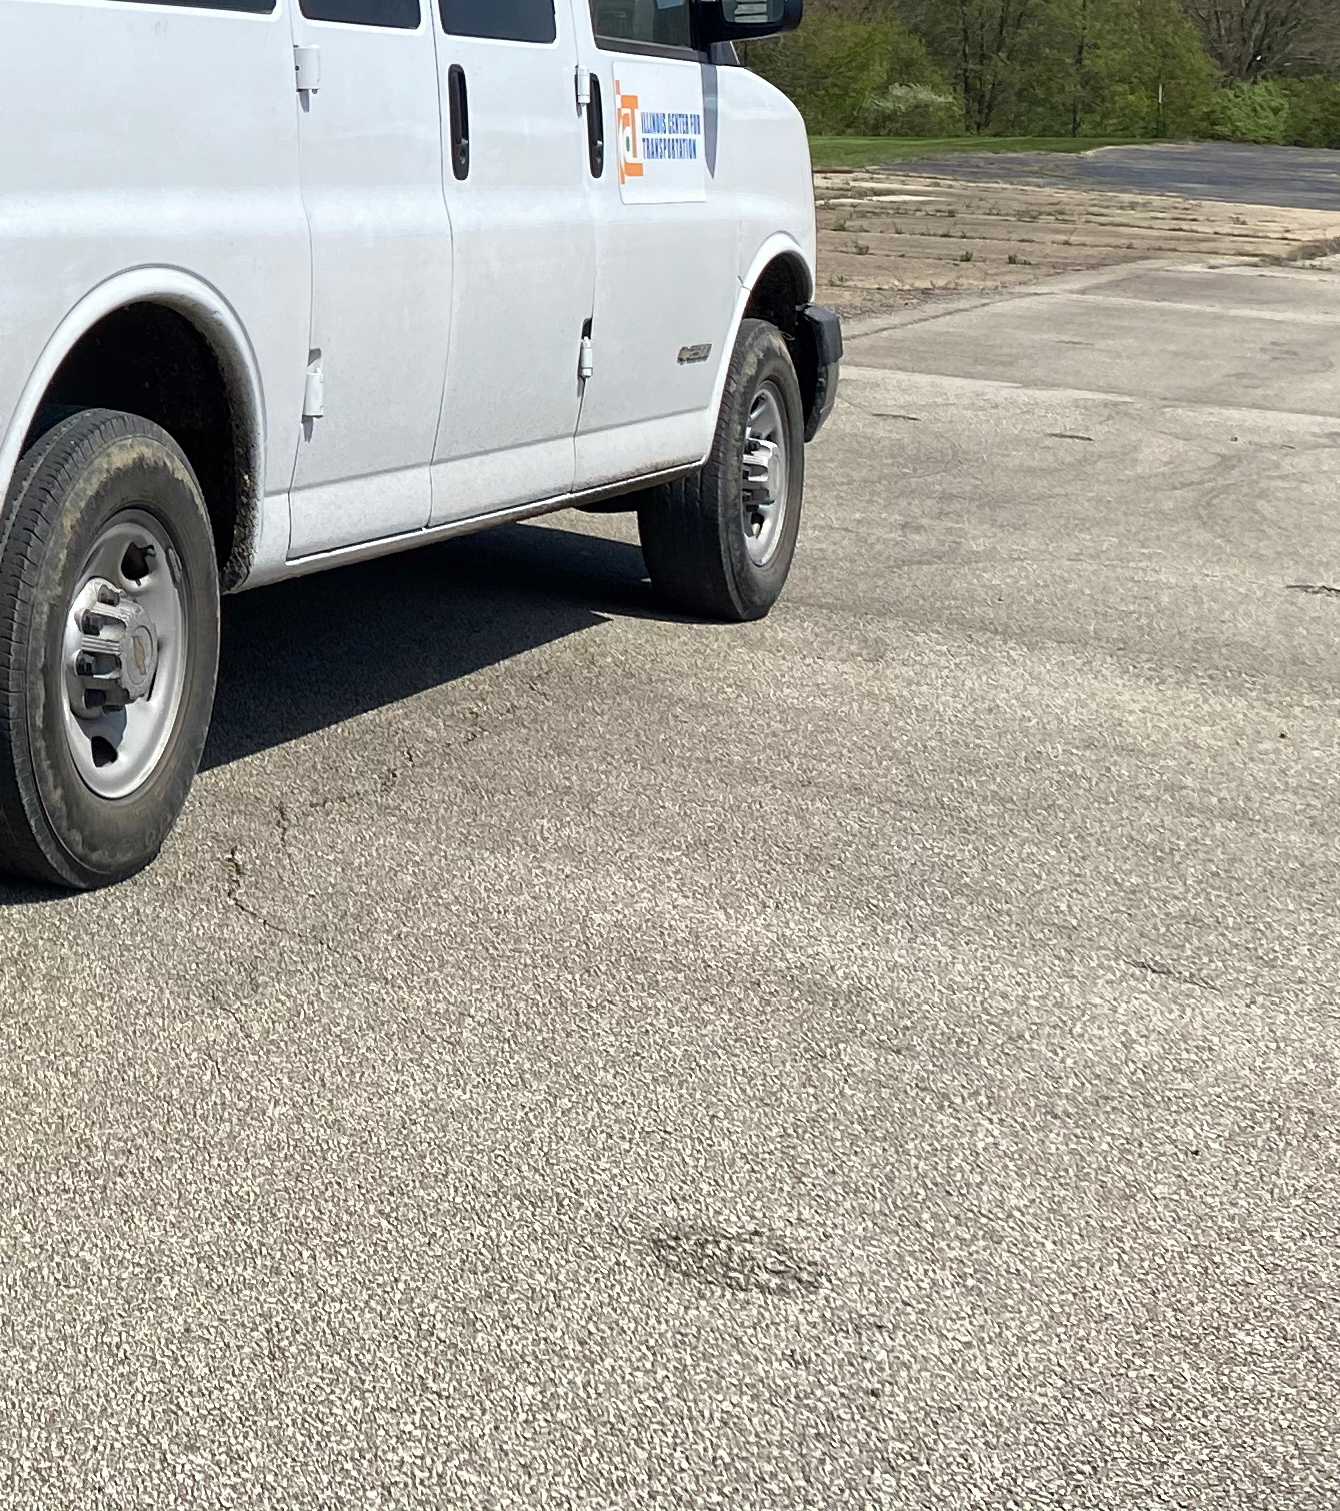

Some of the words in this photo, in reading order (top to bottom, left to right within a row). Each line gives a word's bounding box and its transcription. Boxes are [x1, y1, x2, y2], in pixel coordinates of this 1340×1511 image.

[640, 111, 666, 134] ILLINOIS
[667, 112, 689, 134] CENTER
[690, 113, 701, 135] FOR
[641, 137, 697, 160] TRANSPORTATION
